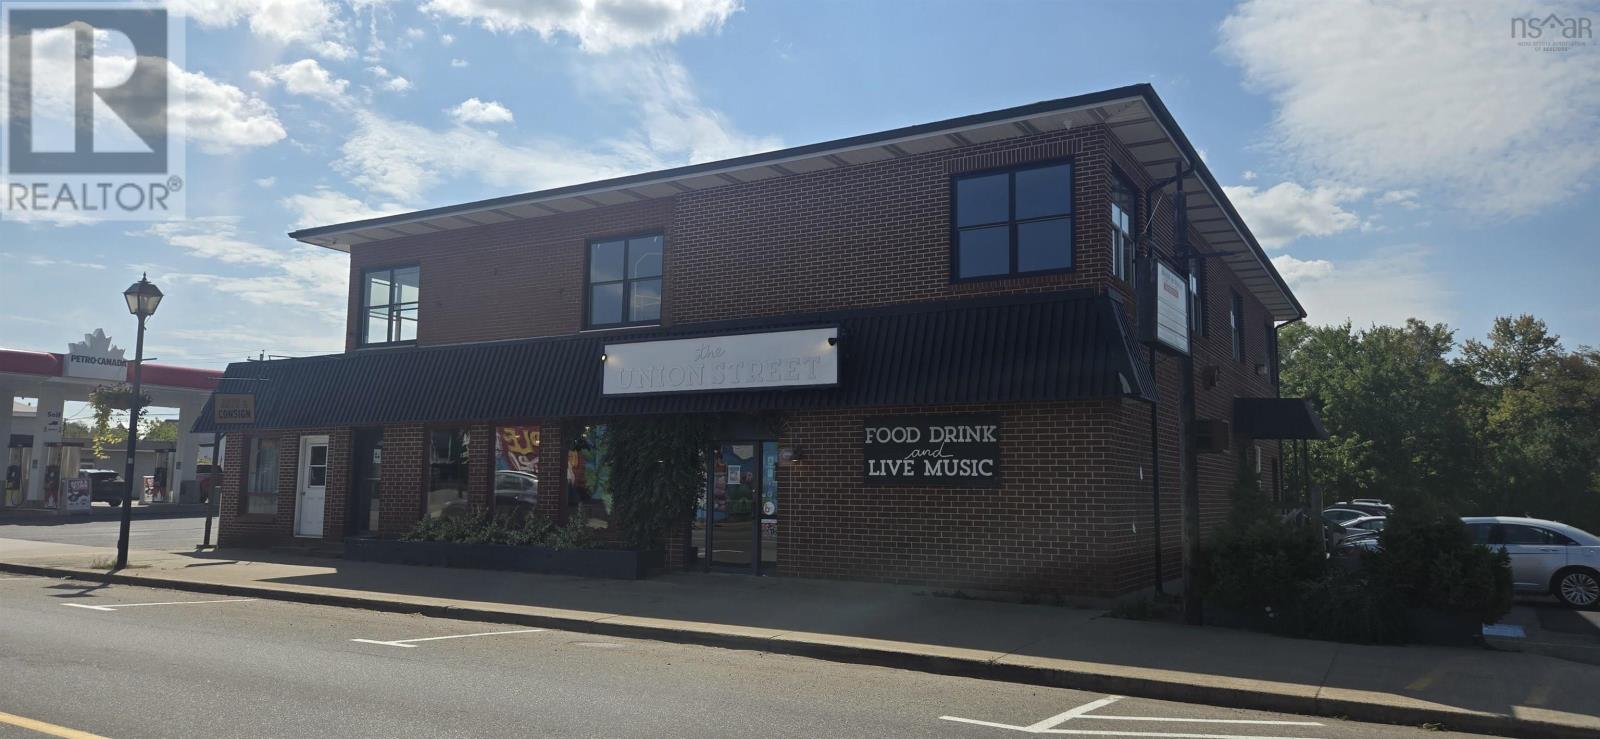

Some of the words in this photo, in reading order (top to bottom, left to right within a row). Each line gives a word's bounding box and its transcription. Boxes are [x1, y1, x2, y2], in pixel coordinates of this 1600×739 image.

[695, 343, 726, 362] the
[618, 364, 705, 389] UNION
[712, 355, 822, 385] STREET
[865, 427, 921, 443] FOOD
[929, 425, 997, 442] DRINK
[904, 441, 954, 460] and
[868, 459, 915, 476] LIVE
[923, 459, 994, 476] MUSIC
